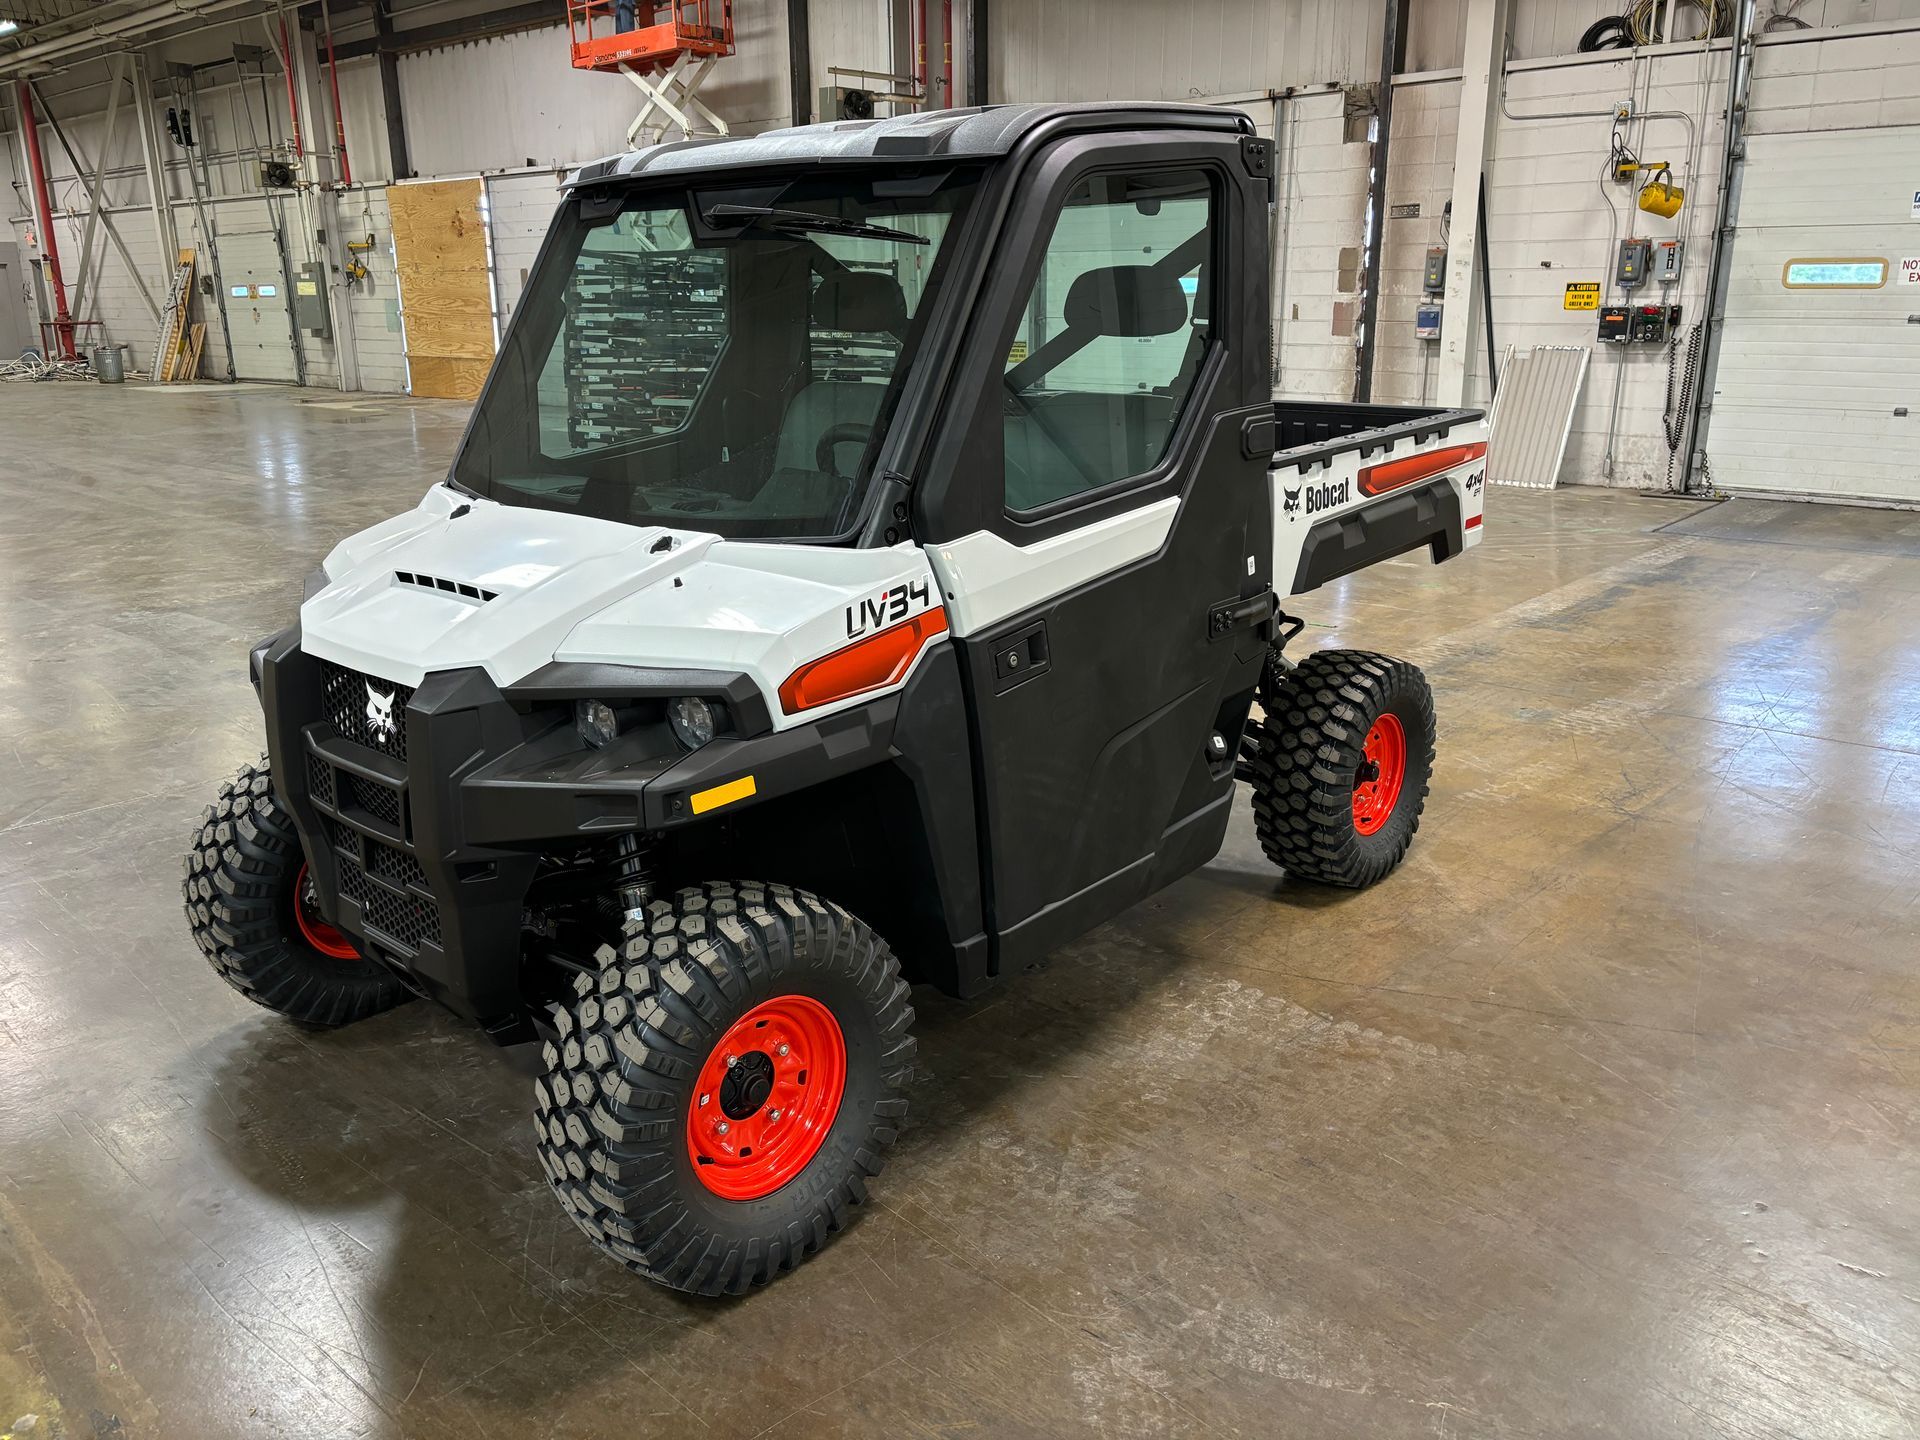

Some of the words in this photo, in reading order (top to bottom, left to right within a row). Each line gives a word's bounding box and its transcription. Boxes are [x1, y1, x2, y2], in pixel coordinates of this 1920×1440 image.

[1305, 477, 1351, 515] Bobcat
[1465, 469, 1485, 491] 4x4
[846, 574, 930, 640] UV34
